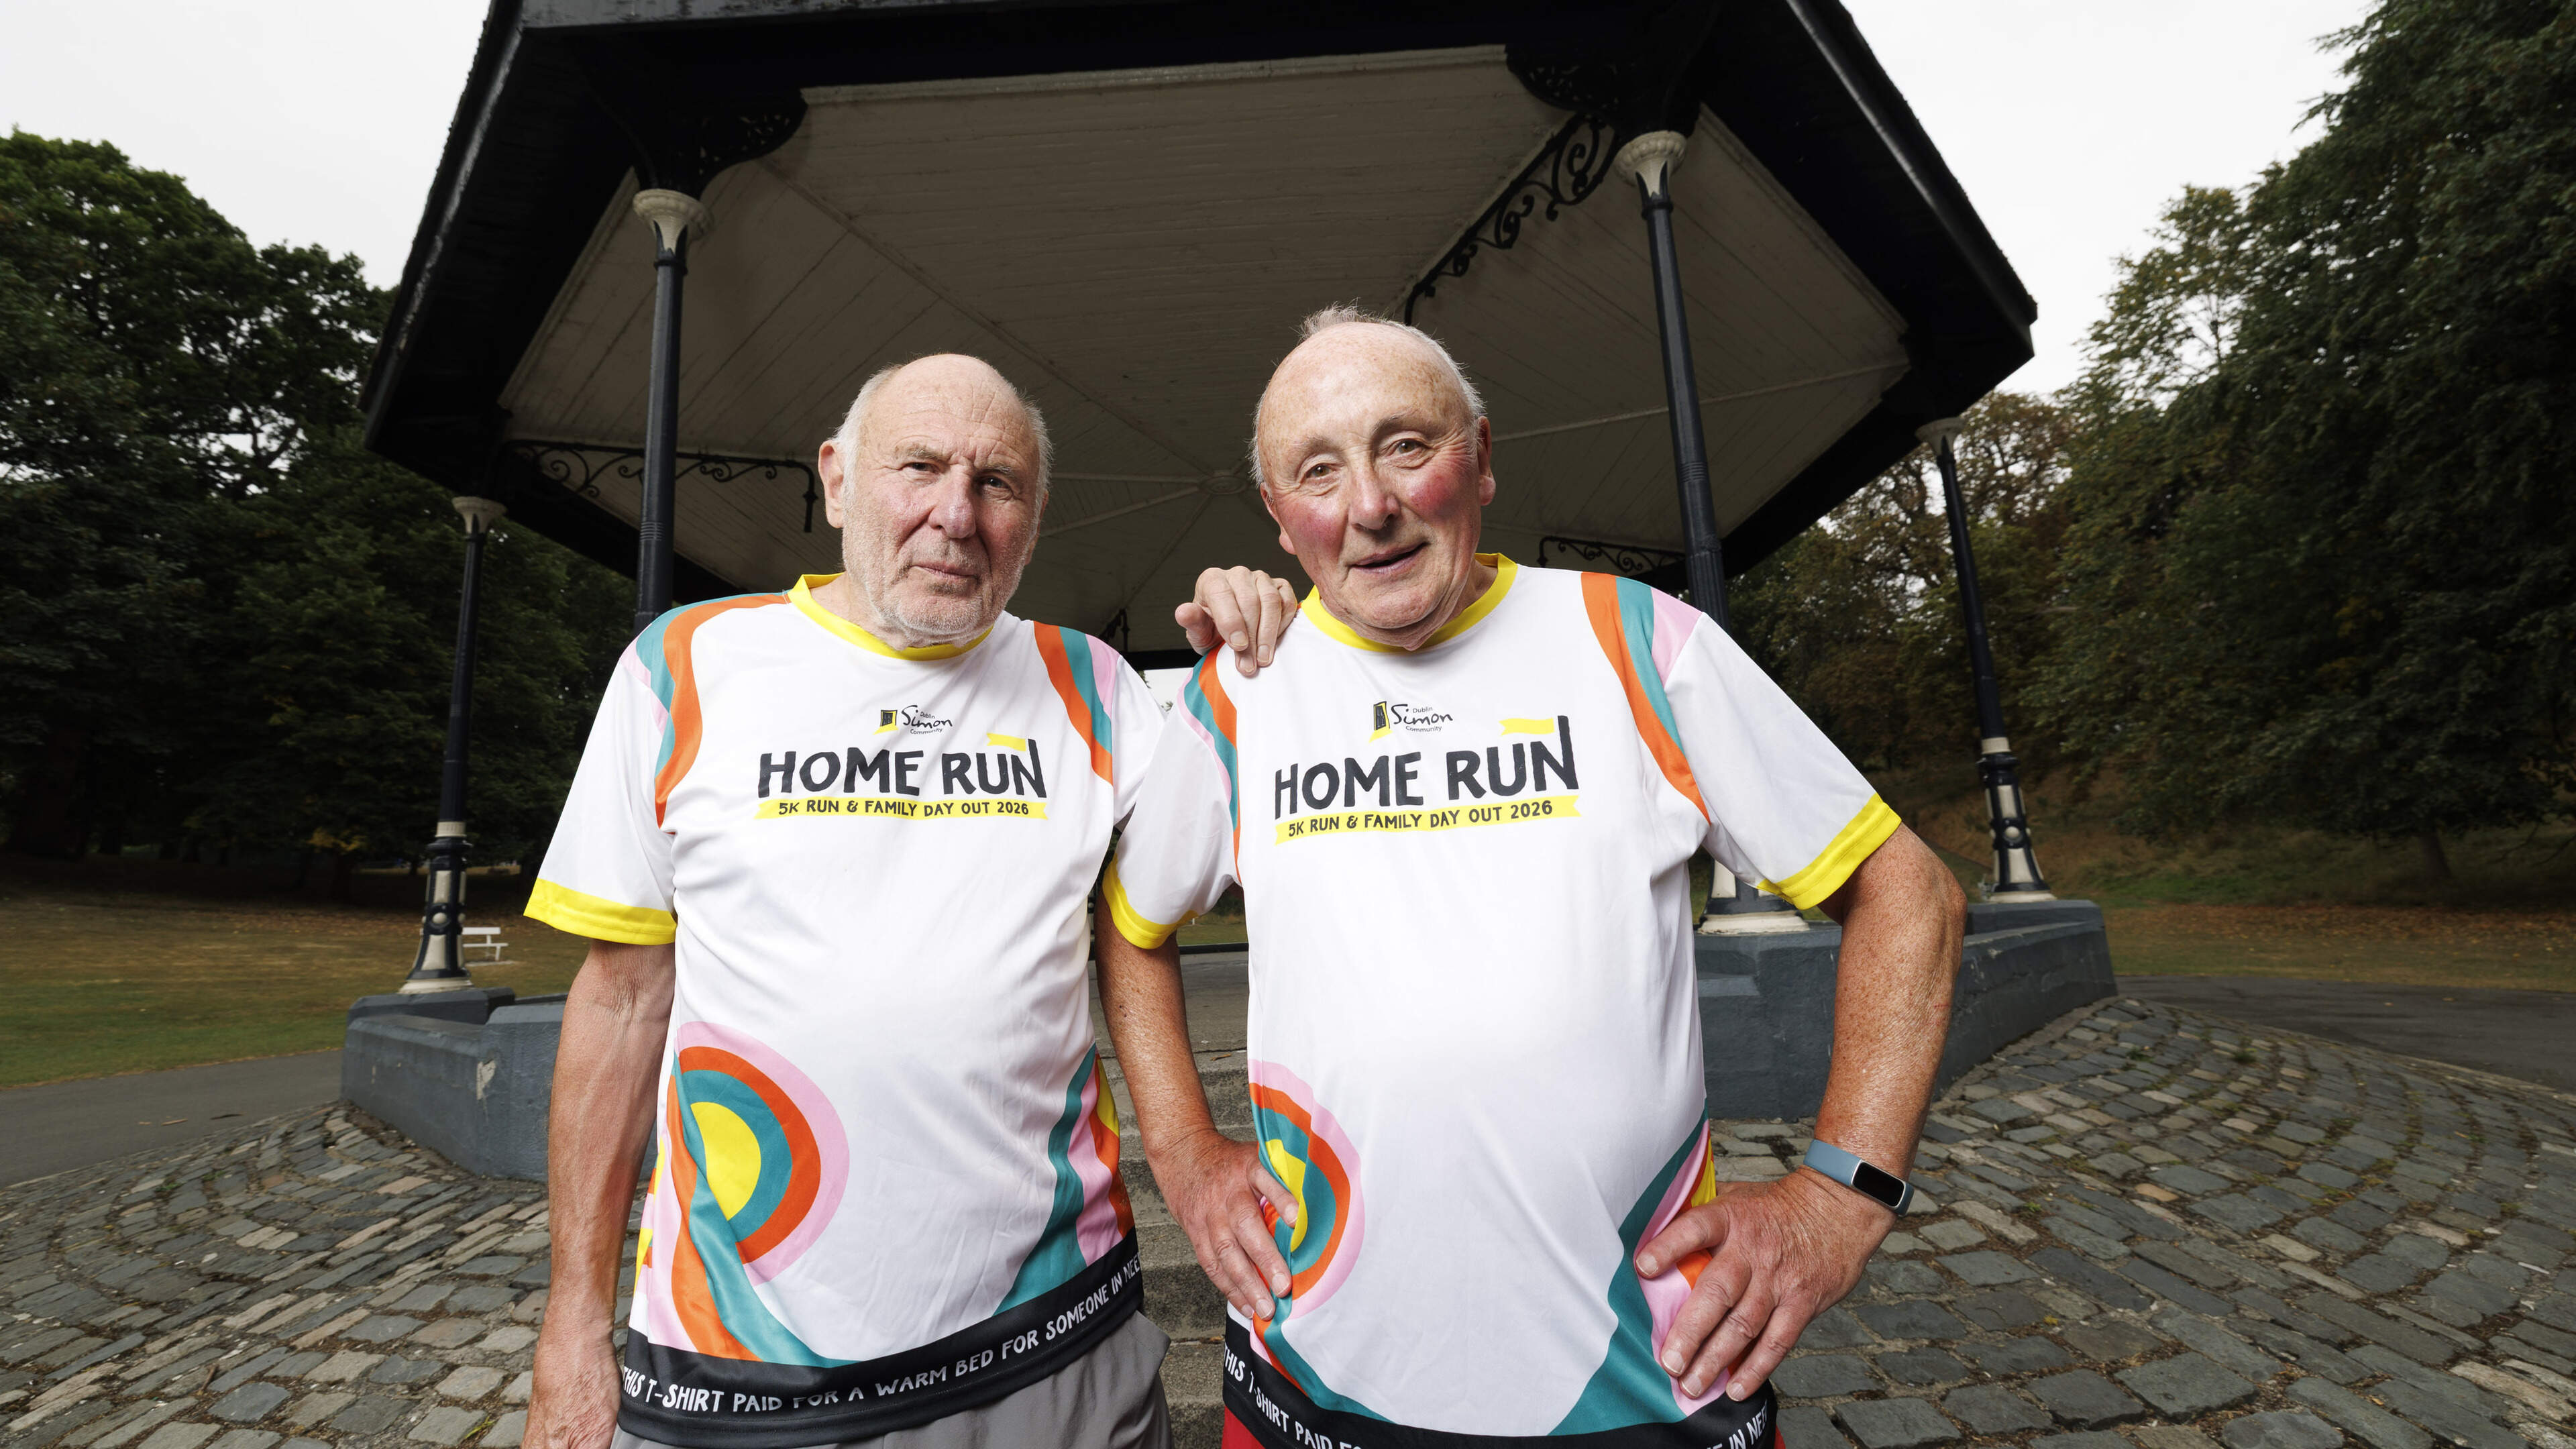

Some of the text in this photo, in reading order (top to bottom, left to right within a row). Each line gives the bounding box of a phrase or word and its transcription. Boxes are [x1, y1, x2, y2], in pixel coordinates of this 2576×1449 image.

[901, 704, 953, 729] Simon
[920, 711, 935, 719] Dublin
[1391, 703, 1453, 725] Simon
[758, 738, 1047, 798] HOME RUN
[1275, 715, 1579, 820] HOME RUN
[779, 799, 1029, 817] 5K RUN & FAMILY DAY OUT 2026
[1288, 800, 1553, 837] 5K RUN & FAMILY DAY OUT 2026
[623, 1252, 1140, 1413] THIS T-SHIRT PAID FOR A WARM BED FOR SOMEONE IN NEE
[1295, 1420, 1333, 1449] PAID
